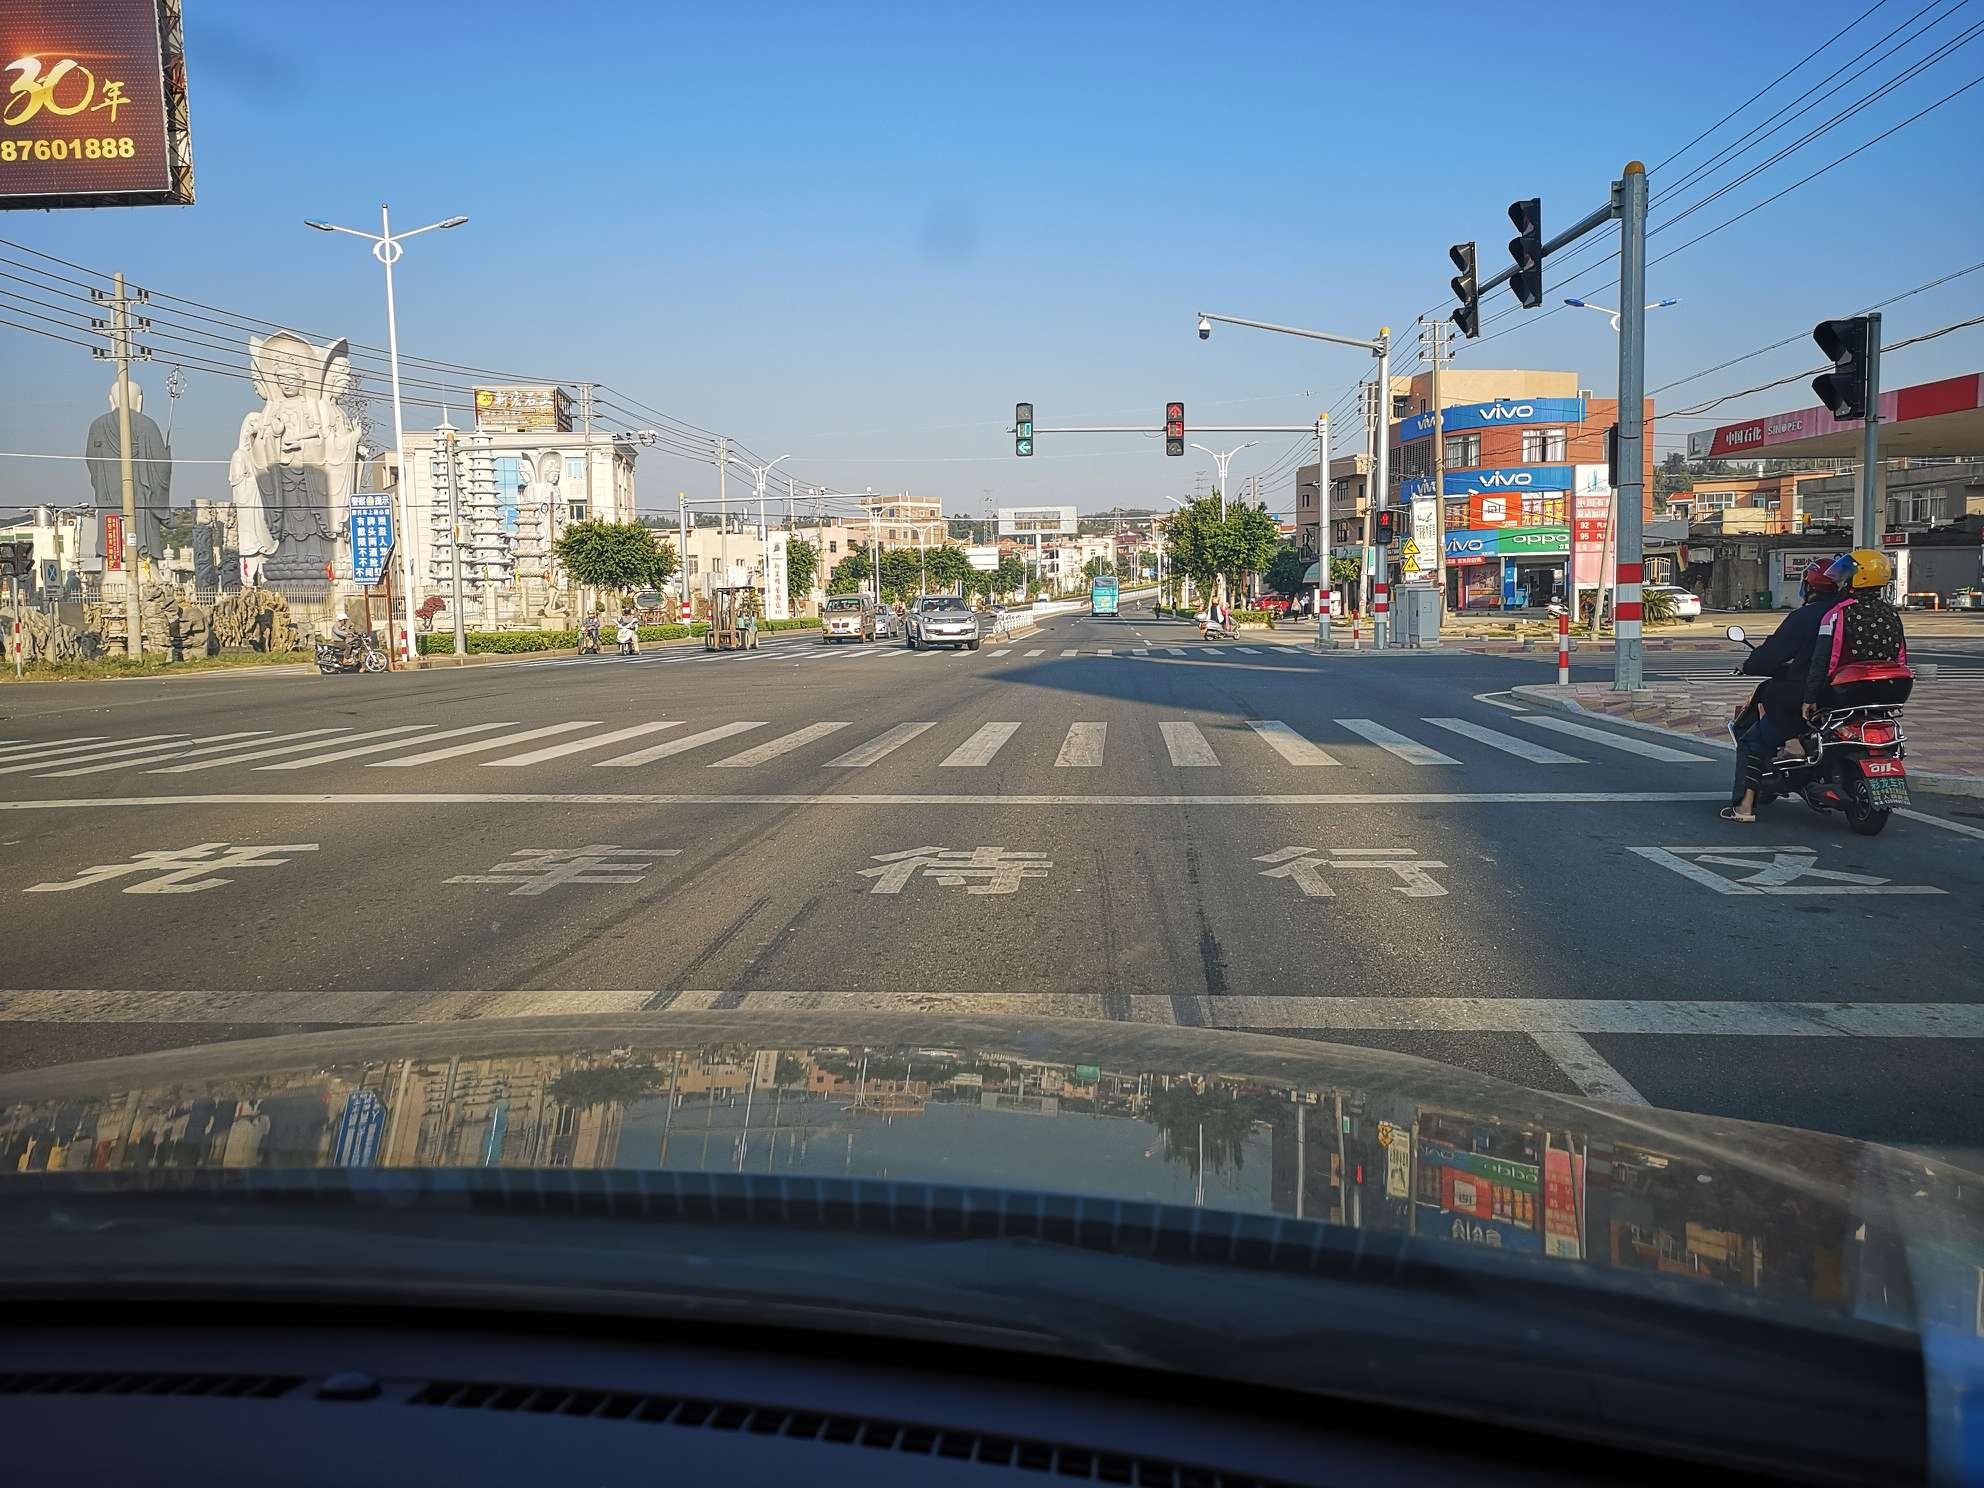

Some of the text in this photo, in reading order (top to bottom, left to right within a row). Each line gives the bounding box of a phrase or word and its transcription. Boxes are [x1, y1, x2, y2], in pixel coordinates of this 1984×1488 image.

[0, 137, 135, 162] 87601888
[1479, 403, 1533, 420] vivo
[1017, 422, 1032, 438] 10
[1726, 420, 1803, 446] 中国石化 SINOPEC
[1479, 470, 1532, 487] vivo
